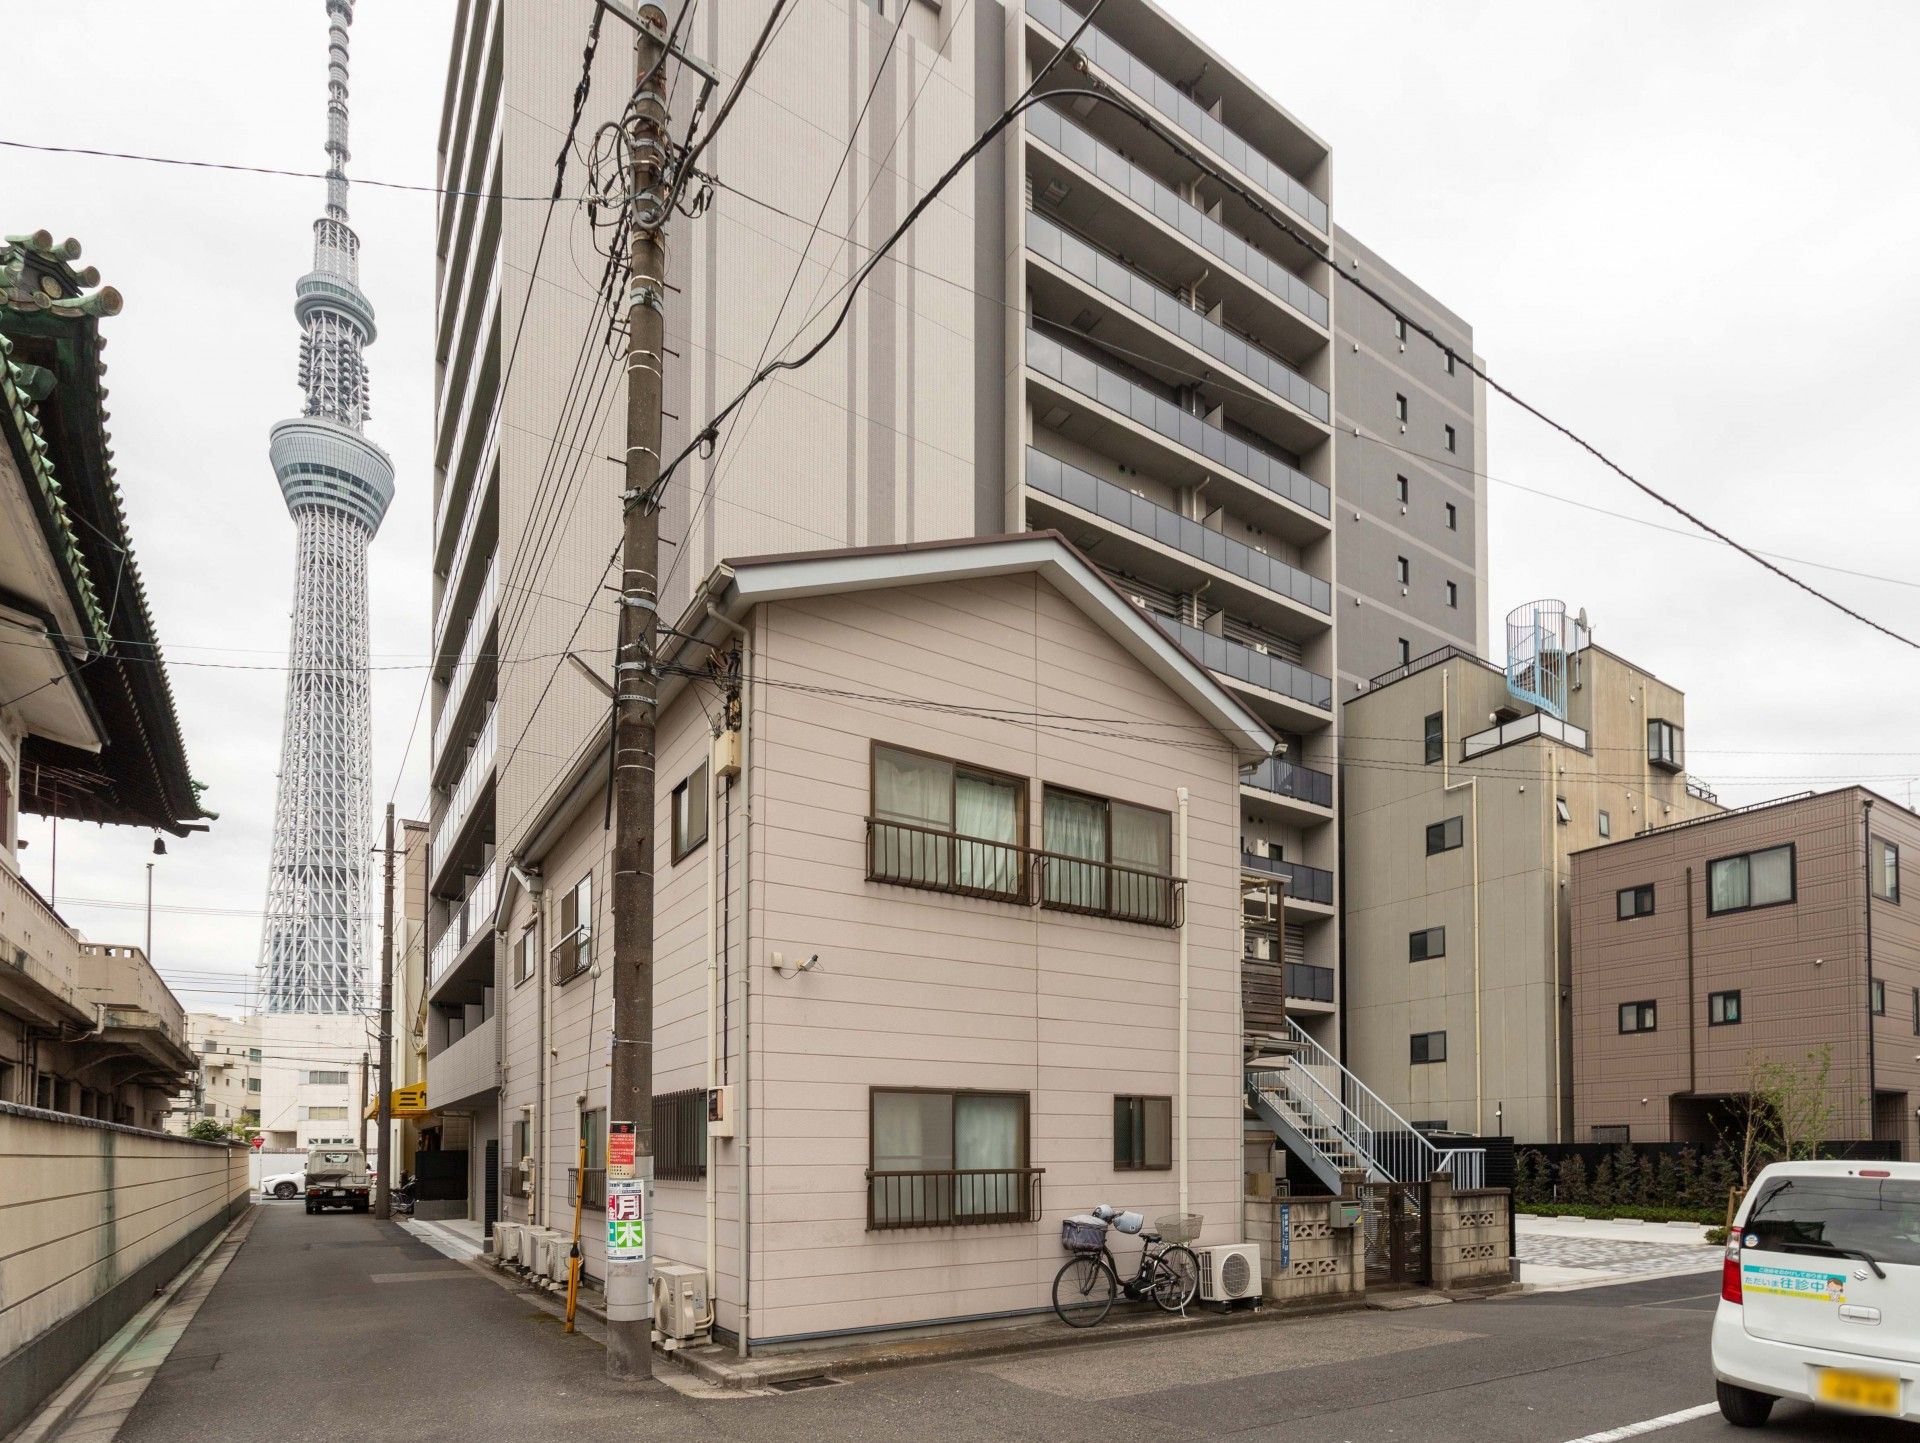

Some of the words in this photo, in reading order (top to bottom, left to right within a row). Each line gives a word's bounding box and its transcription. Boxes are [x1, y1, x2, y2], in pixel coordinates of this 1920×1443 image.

[617, 1194, 640, 1219] 月
[617, 1222, 642, 1246] 木
[1744, 1276, 1825, 1292] ただいま往診中
